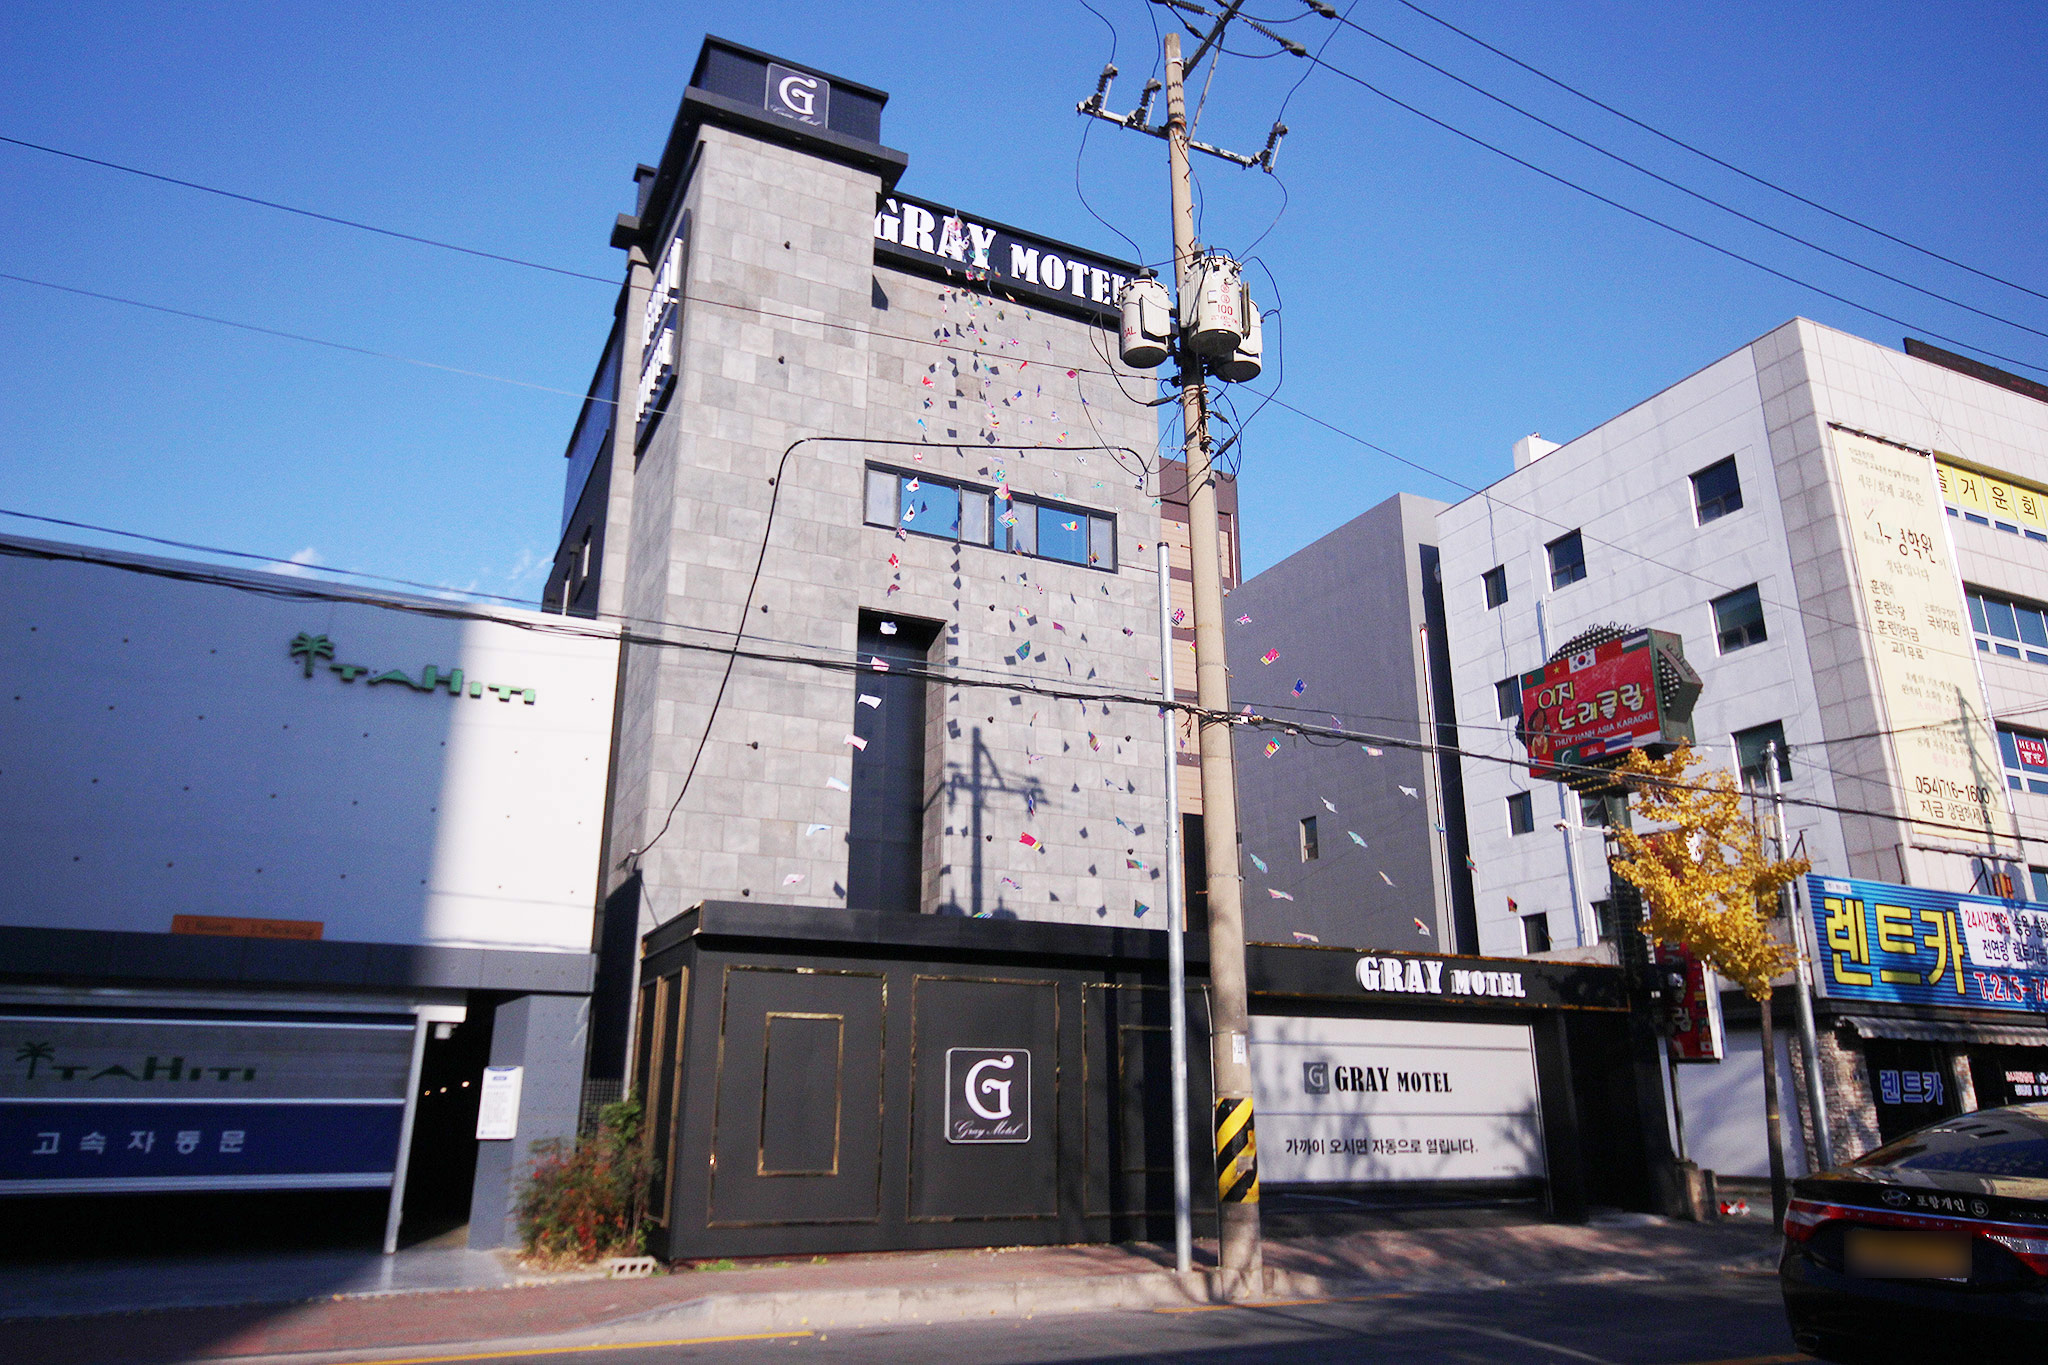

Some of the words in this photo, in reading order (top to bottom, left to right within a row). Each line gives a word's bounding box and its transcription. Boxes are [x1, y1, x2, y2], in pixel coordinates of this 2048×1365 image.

[873, 198, 997, 271] GRAY
[1928, 614, 1961, 637] 국비지원
[1557, 682, 1645, 731] 노래클럽
[1597, 724, 1615, 737] ASIA
[1616, 710, 1655, 730] KARAOKE
[2018, 739, 2043, 752] HERA
[1921, 800, 1944, 819] 지금
[1965, 908, 2011, 935] 24시간영업
[1823, 897, 1966, 995] 렌트카
[1981, 938, 2010, 962] 전연령
[1356, 956, 1444, 995] GRAY
[1450, 969, 1527, 998] MOTEL
[964, 1054, 1015, 1121] G
[1334, 1065, 1389, 1093] GRAY
[1397, 1072, 1452, 1093] MOTEL
[1879, 1069, 1944, 1106] 렌트카
[1285, 1138, 1325, 1156] 가까이
[1329, 1138, 1369, 1156] 오시면
[1371, 1138, 1423, 1156] 자동으로
[1426, 1137, 1479, 1155] 열립니다.
[1916, 1194, 1967, 1213] 포항개인
